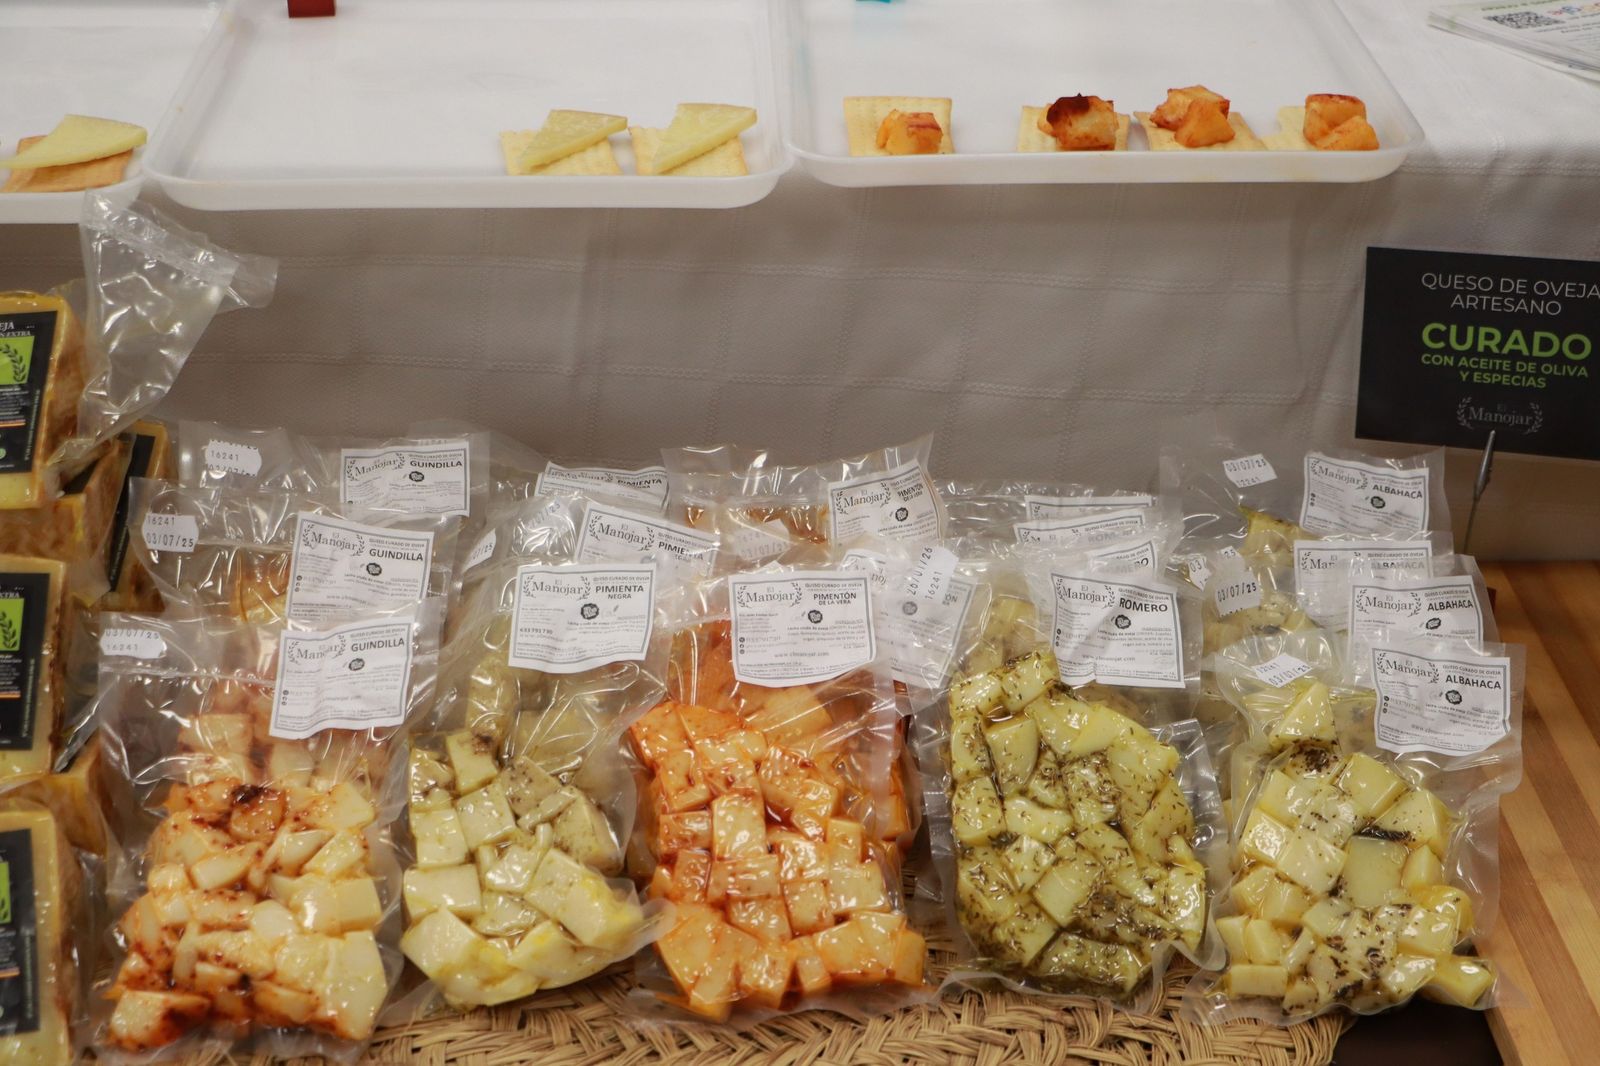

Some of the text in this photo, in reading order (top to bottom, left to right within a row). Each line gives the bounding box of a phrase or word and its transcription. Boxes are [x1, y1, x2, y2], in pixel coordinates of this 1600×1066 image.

[1421, 272, 1600, 300] QUESO DE OVEJA
[1450, 294, 1562, 316] ARTESANO
[1422, 322, 1592, 360] CURADO
[1421, 353, 1588, 378] CON ACEITE DE OLIVA
[1460, 371, 1546, 388] Y ESPECIAS
[1469, 406, 1533, 426] Manojar
[211, 451, 239, 461] 16241
[354, 458, 397, 477] Manojar
[410, 460, 462, 469] GUINDILLA
[1226, 459, 1266, 472] 03/07/25
[1318, 466, 1361, 485] Manojar
[1372, 484, 1422, 499] ALBAHACA
[844, 492, 885, 508] Manojar
[147, 515, 175, 525] 16241
[146, 534, 194, 548] 03/07/25
[311, 532, 357, 551] Manojar
[598, 522, 647, 545] Manojar
[370, 548, 423, 560] GUINDILLA
[658, 541, 704, 560] PIMIEA
[532, 581, 584, 596] Manojar
[746, 590, 795, 603] Manojar
[814, 591, 857, 600] PIMENTÓN
[1062, 586, 1107, 604] Manojar
[1218, 582, 1256, 602] 03/07/25
[1120, 598, 1168, 612] ROMERO
[1365, 596, 1414, 612] Manojar
[1428, 600, 1473, 611] ALBAHACA
[351, 638, 404, 652] GUINDILLA
[1386, 660, 1432, 678] Manojar
[1446, 675, 1501, 689] ALBAHACA
